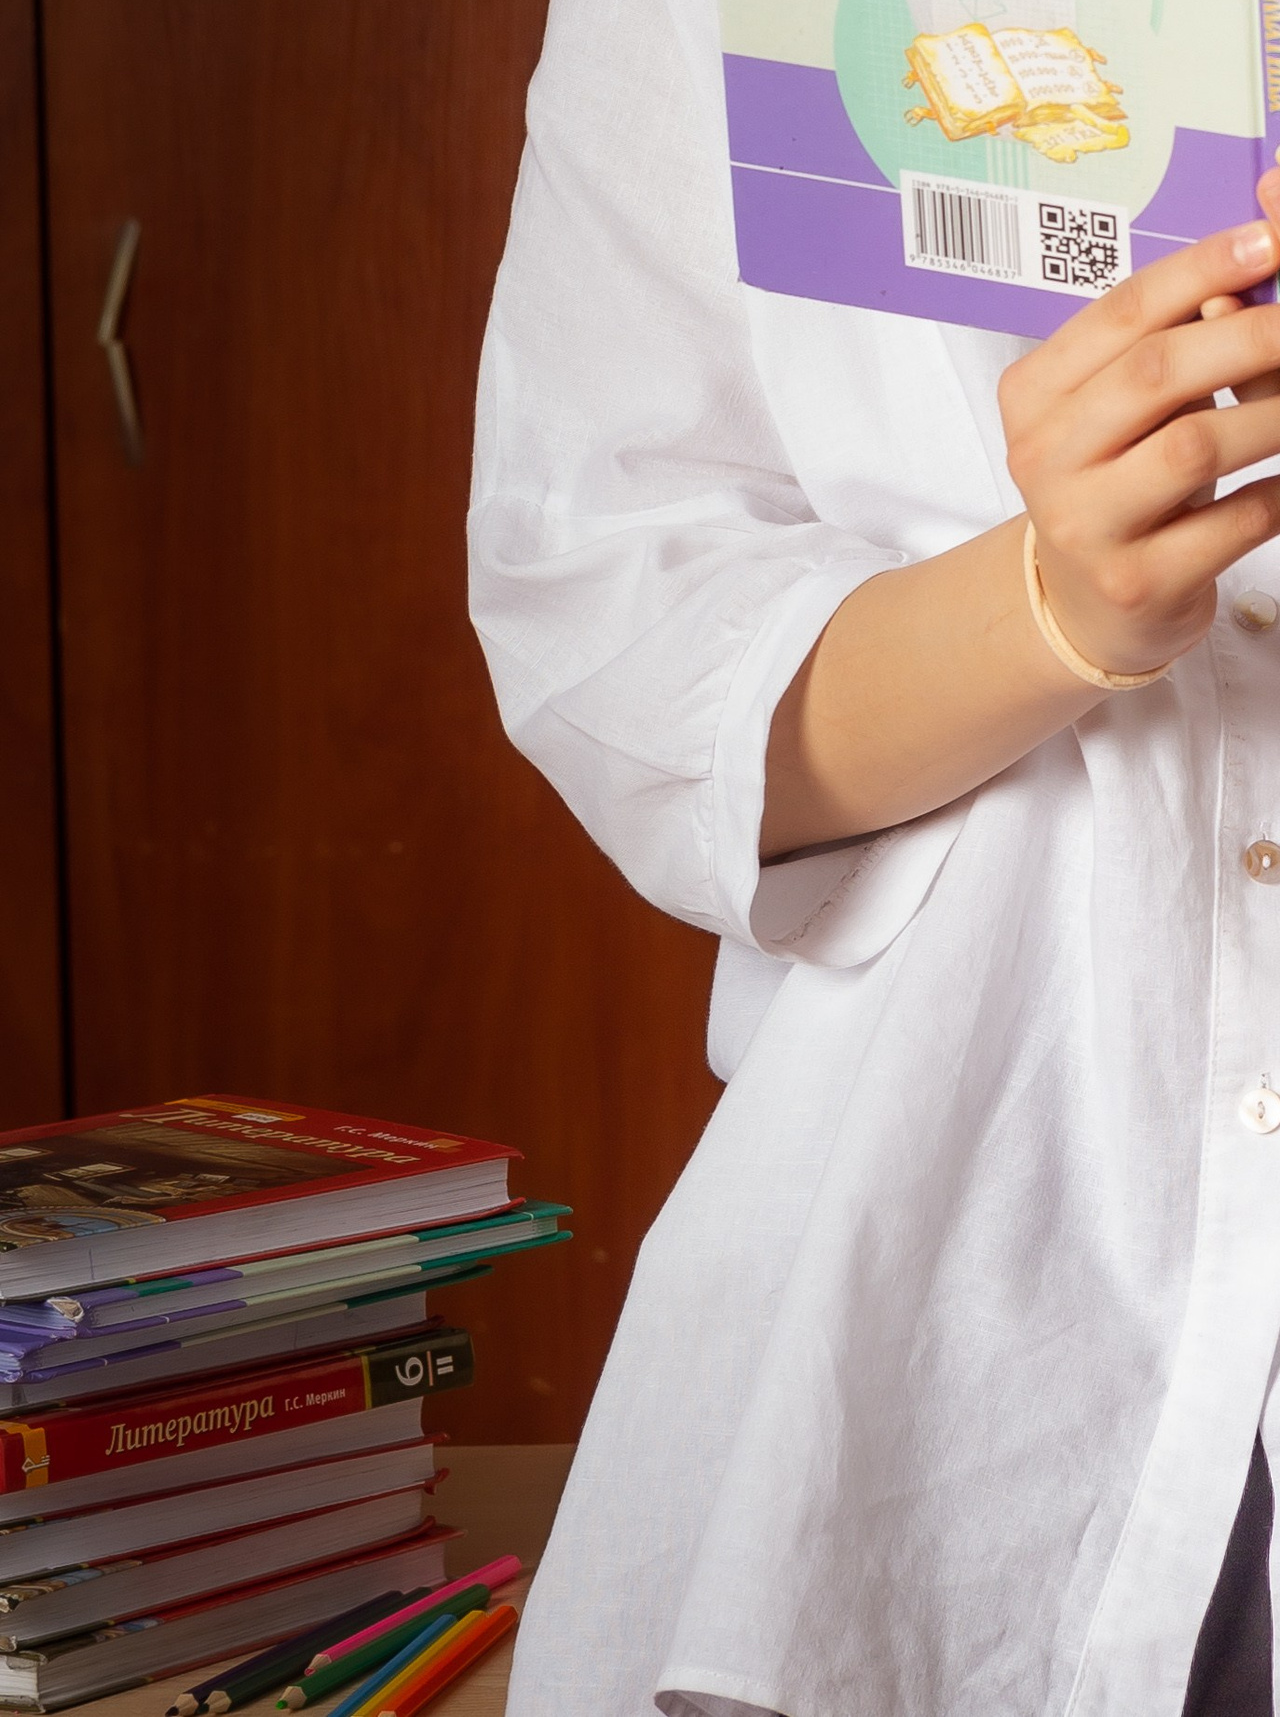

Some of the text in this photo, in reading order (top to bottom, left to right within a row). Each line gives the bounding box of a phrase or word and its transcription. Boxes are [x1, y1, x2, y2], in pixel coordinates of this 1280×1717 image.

[970, 264, 1018, 281] 046837
[118, 1108, 421, 1164] Литература
[367, 1131, 440, 1150] Меркин
[394, 1356, 425, 1387] 6
[104, 1387, 347, 1456] Литература Г.С. Меркин
